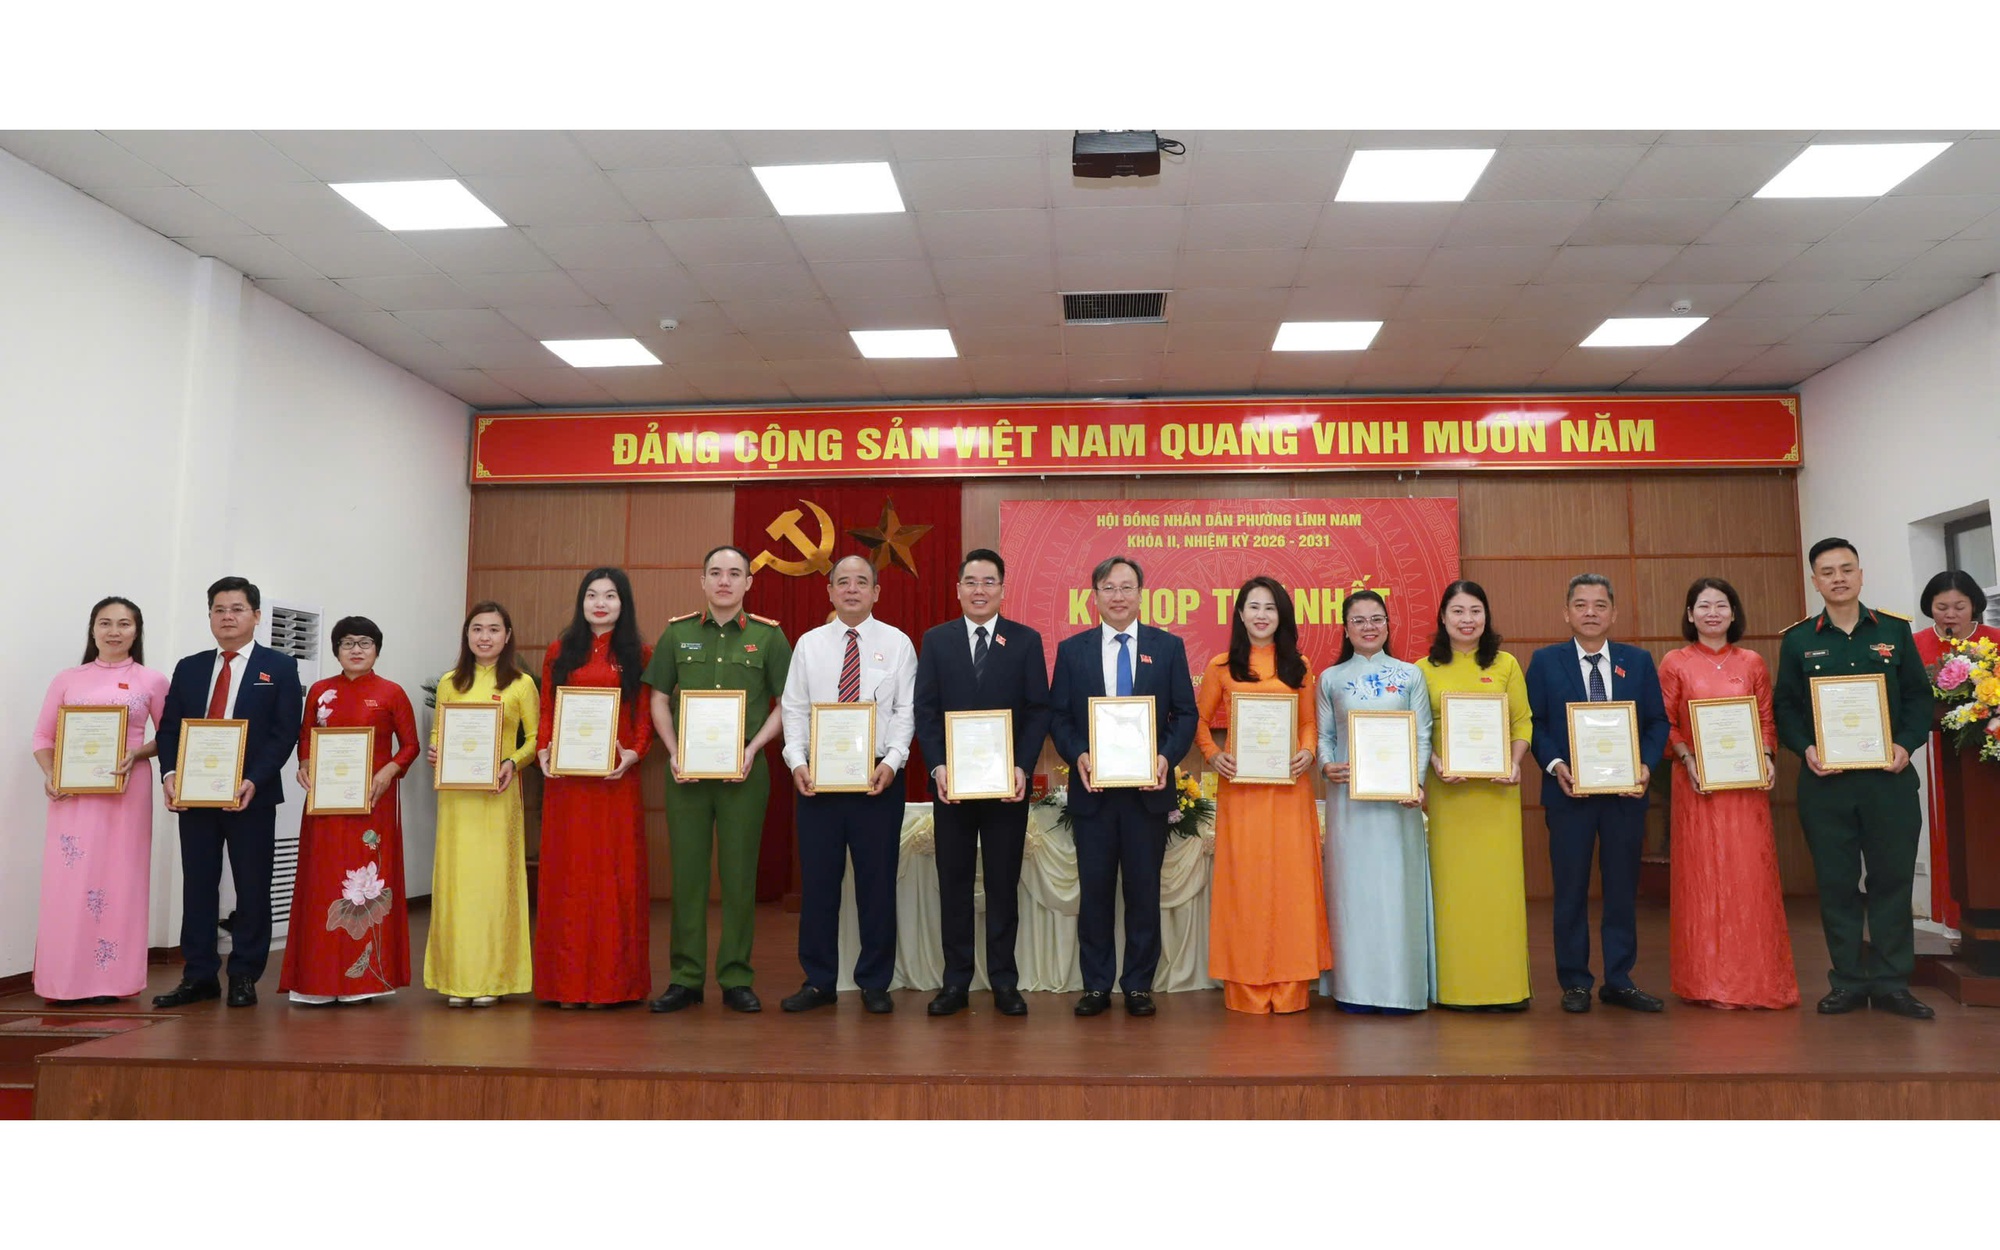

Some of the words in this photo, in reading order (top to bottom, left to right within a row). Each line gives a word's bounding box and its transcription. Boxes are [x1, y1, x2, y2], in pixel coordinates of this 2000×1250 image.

[612, 422, 720, 465] ĐẢNG
[735, 423, 842, 469] CỘNG
[856, 417, 939, 461] SẢN
[953, 419, 1038, 466] VIỆT
[1051, 424, 1146, 458] NAM
[1160, 423, 1299, 460] QUANG
[1312, 421, 1409, 455] VINH
[1423, 413, 1547, 454] MUÔN
[1560, 412, 1656, 453] NĂM
[1096, 512, 1119, 529] HỘI
[1123, 511, 1160, 527] ĐỒNG
[1163, 512, 1202, 527] NHÂN
[1205, 512, 1233, 527] DÂN
[1237, 511, 1292, 527] PHƯỜNG
[1296, 511, 1326, 526] LĨNH
[1330, 513, 1362, 526] NAM
[1127, 532, 1163, 548] KHÓA
[1168, 534, 1181, 549] II,
[1184, 532, 1228, 550] NHIỆM
[1232, 532, 1250, 548] KỲ
[1253, 534, 1286, 548] 2026
[1299, 534, 1330, 547] 2031
[1069, 588, 1102, 625] K
